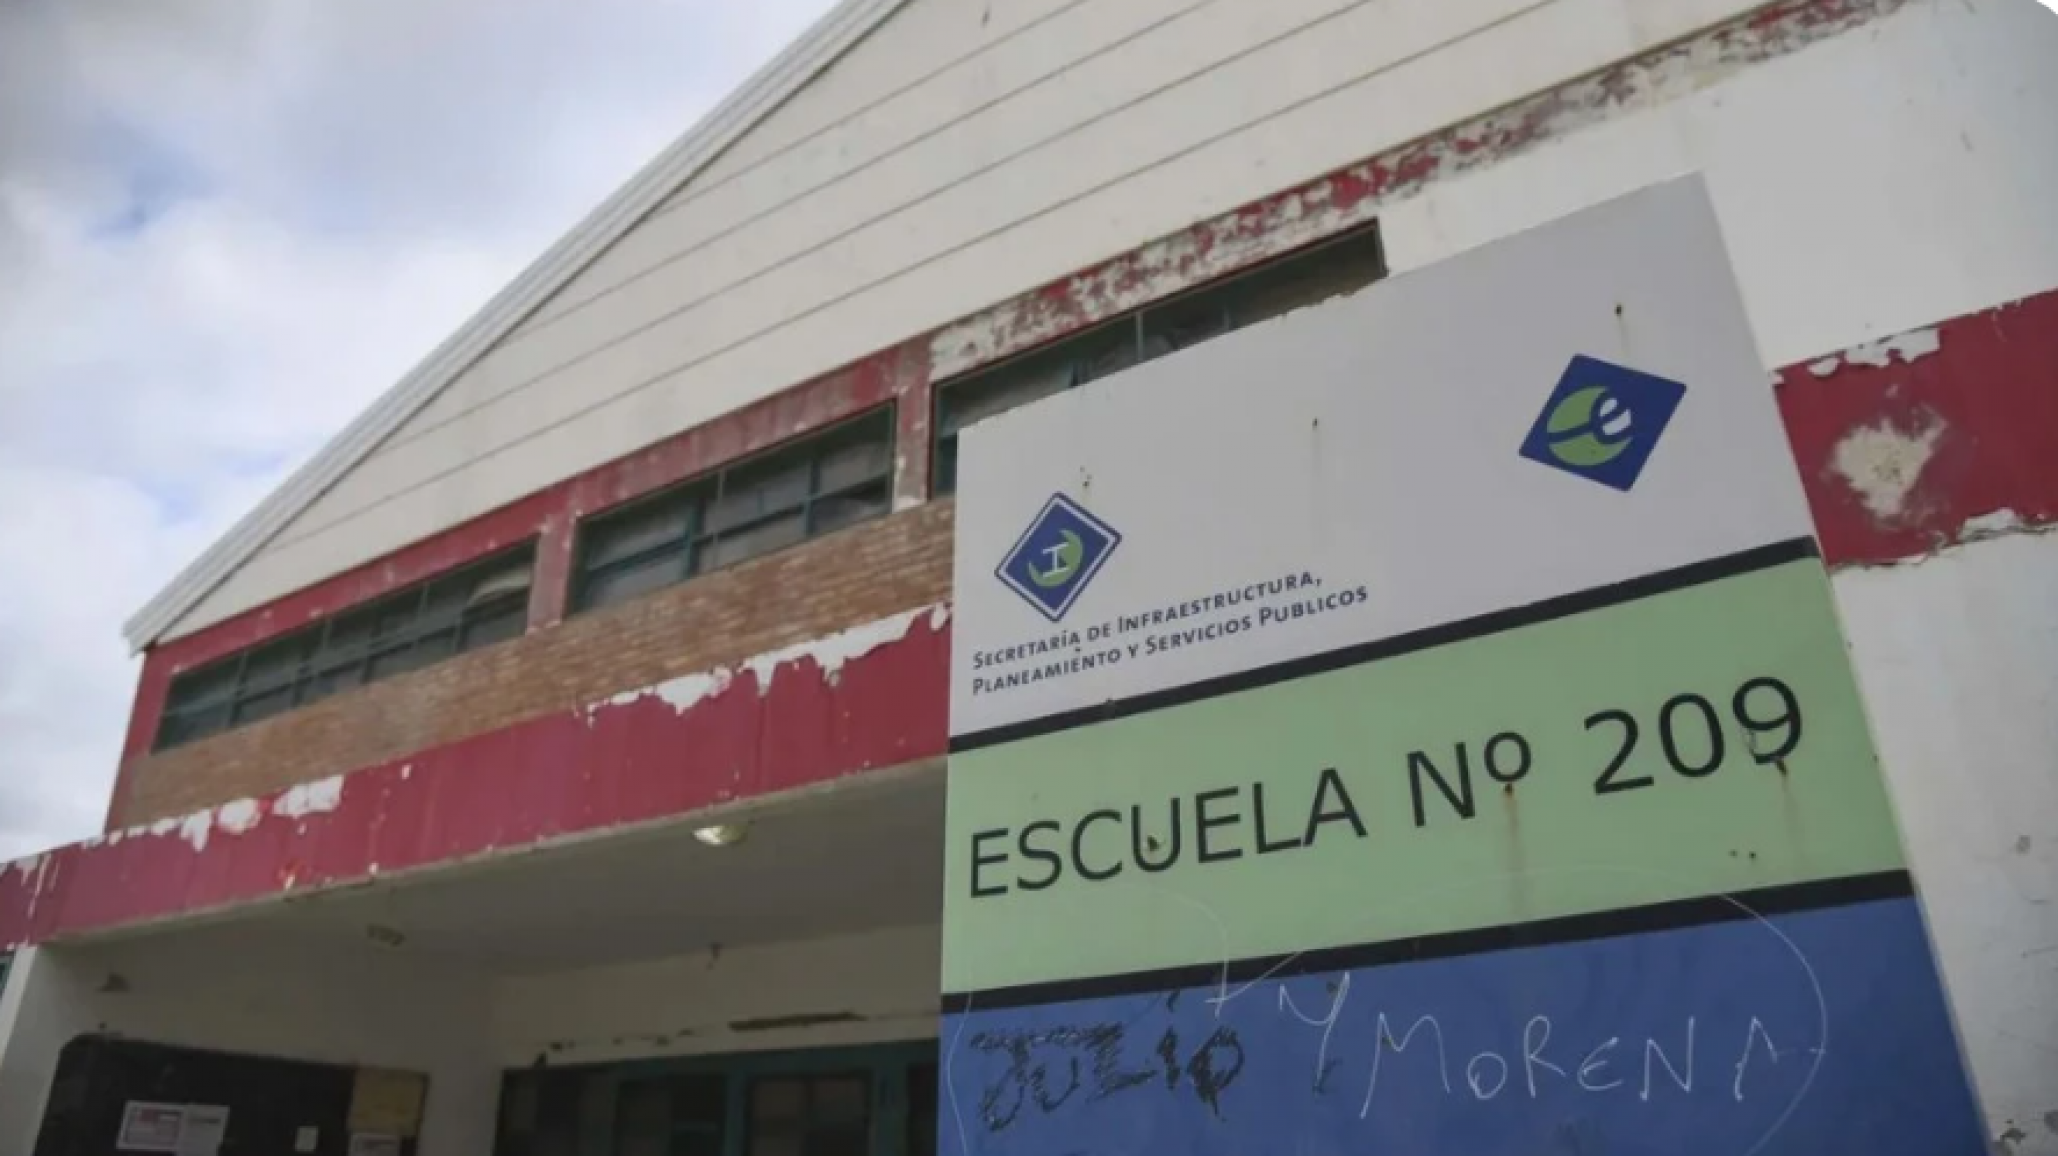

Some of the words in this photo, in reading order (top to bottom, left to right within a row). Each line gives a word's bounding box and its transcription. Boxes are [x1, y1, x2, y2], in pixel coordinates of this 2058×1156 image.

[972, 647, 1122, 696] PLANEAMIENTO
[1144, 614, 1252, 655] SERVICIOS
[1259, 584, 1369, 627] PUBLICOS
[1086, 621, 1112, 642] DE
[1117, 571, 1322, 633] INFRAESTRUCTURA,
[969, 767, 1369, 899] ESCUELA
[1583, 676, 1803, 796] 209
